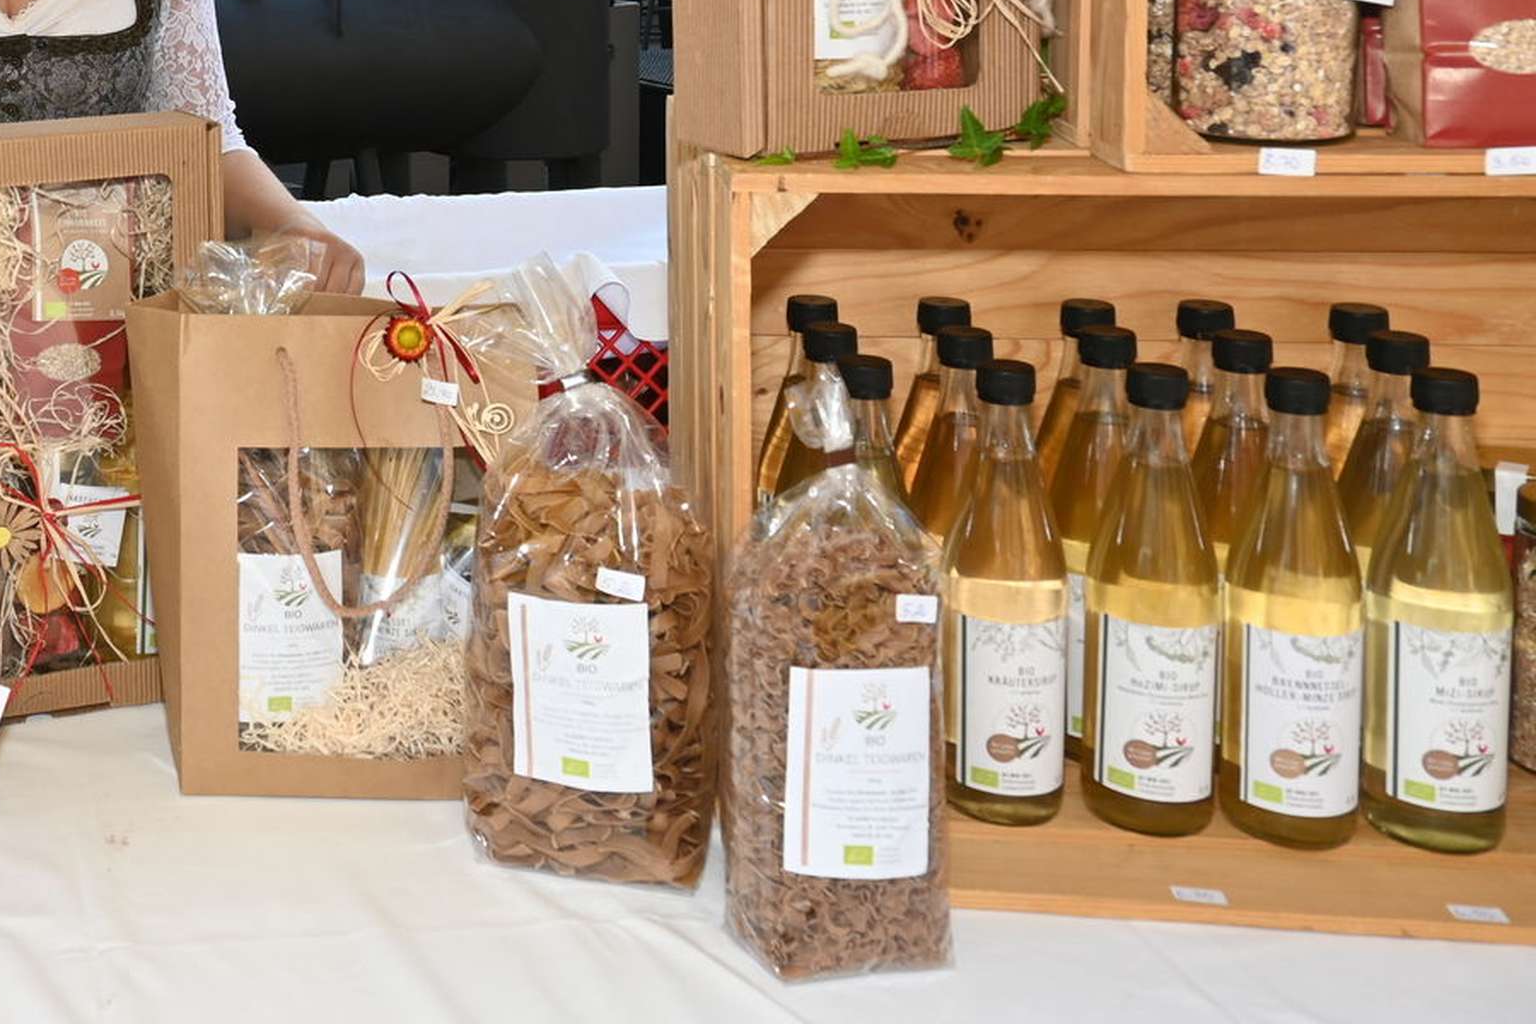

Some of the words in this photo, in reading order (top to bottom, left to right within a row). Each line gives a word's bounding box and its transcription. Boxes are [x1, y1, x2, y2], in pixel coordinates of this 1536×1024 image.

[284, 610, 302, 620] BIO
[577, 664, 597, 674] BIO
[1018, 666, 1035, 676] BIO
[1459, 677, 1478, 687] BIO
